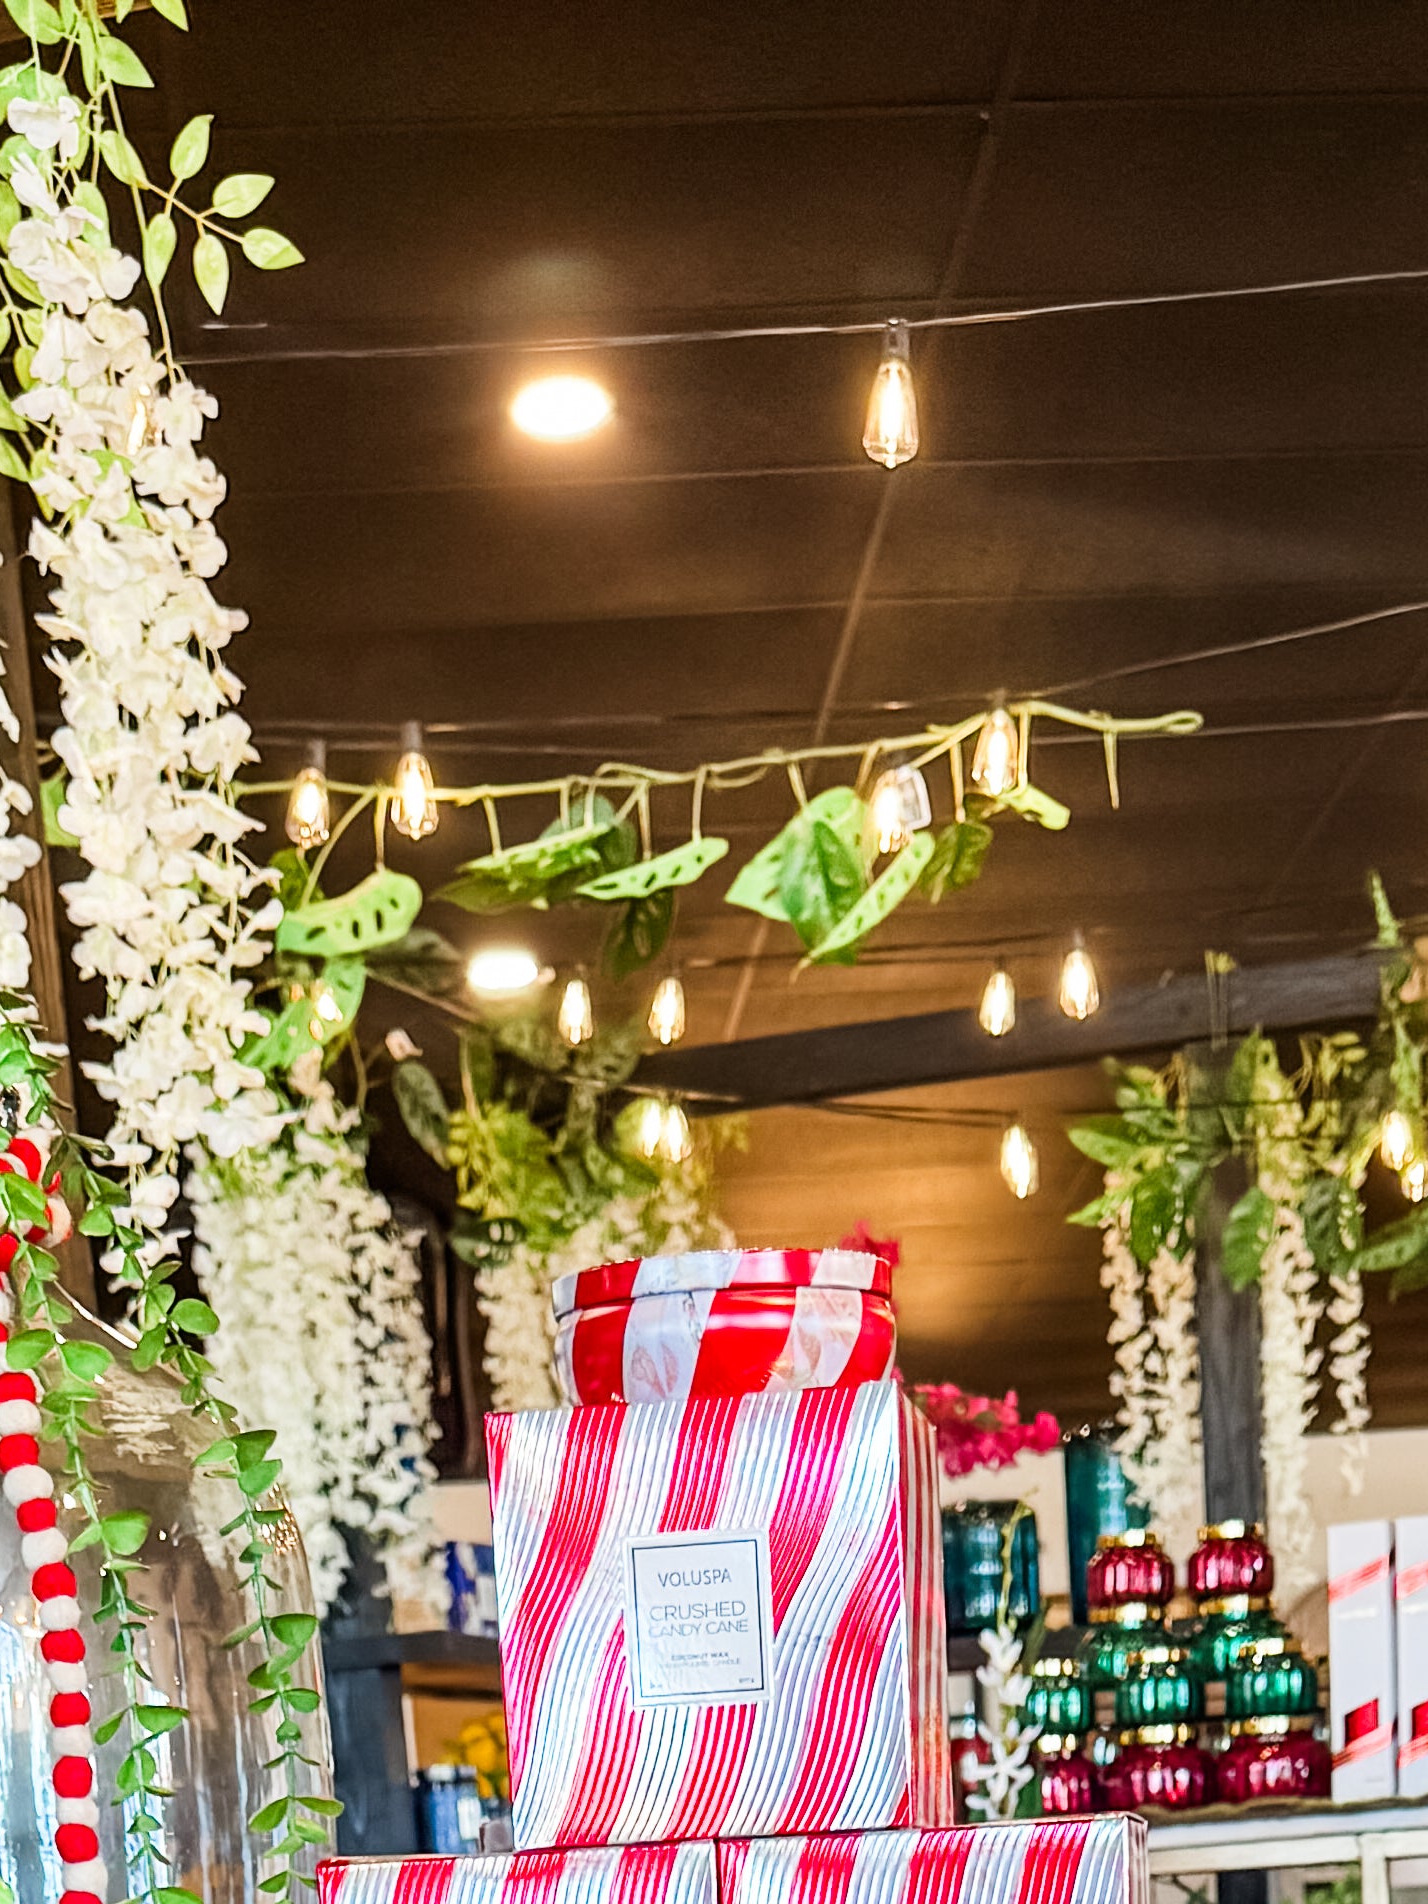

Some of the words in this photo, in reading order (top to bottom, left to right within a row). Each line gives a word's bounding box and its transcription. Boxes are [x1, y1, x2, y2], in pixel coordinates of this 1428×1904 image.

[658, 1568, 732, 1587] VOLUSPA
[650, 1601, 746, 1621] CRUSHED
[649, 1624, 701, 1638] CANDY
[706, 1619, 748, 1635] CANE
